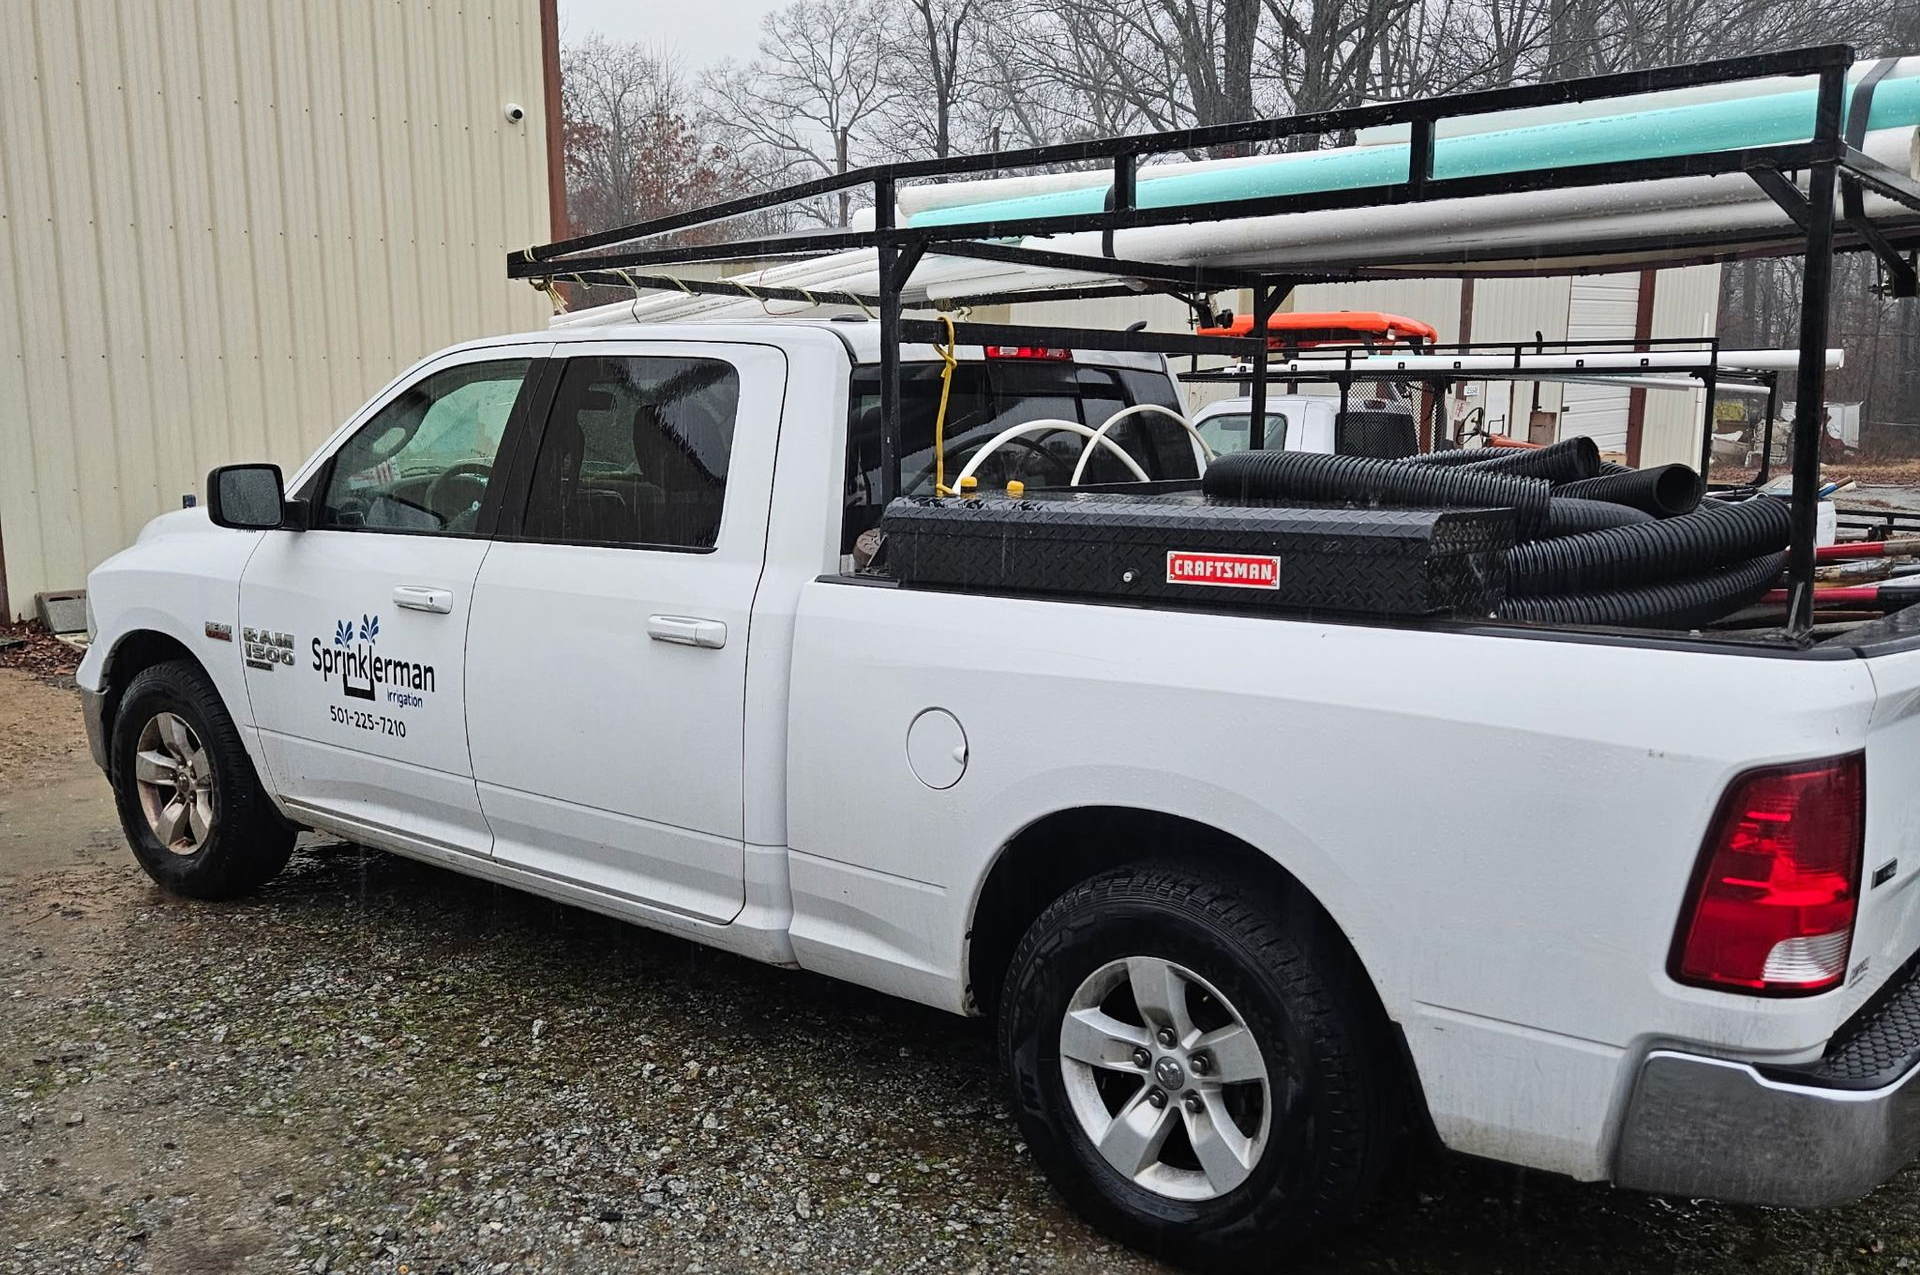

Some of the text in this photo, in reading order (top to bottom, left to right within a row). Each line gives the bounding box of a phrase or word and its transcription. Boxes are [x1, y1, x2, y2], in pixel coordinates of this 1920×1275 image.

[1174, 559, 1273, 581] CRAFTSMAN
[243, 627, 295, 650] RAM
[245, 643, 296, 666] 1500
[311, 637, 435, 693] Sprinklerman
[386, 689, 423, 708] Irrigation
[330, 705, 406, 738] 501-225-7210
